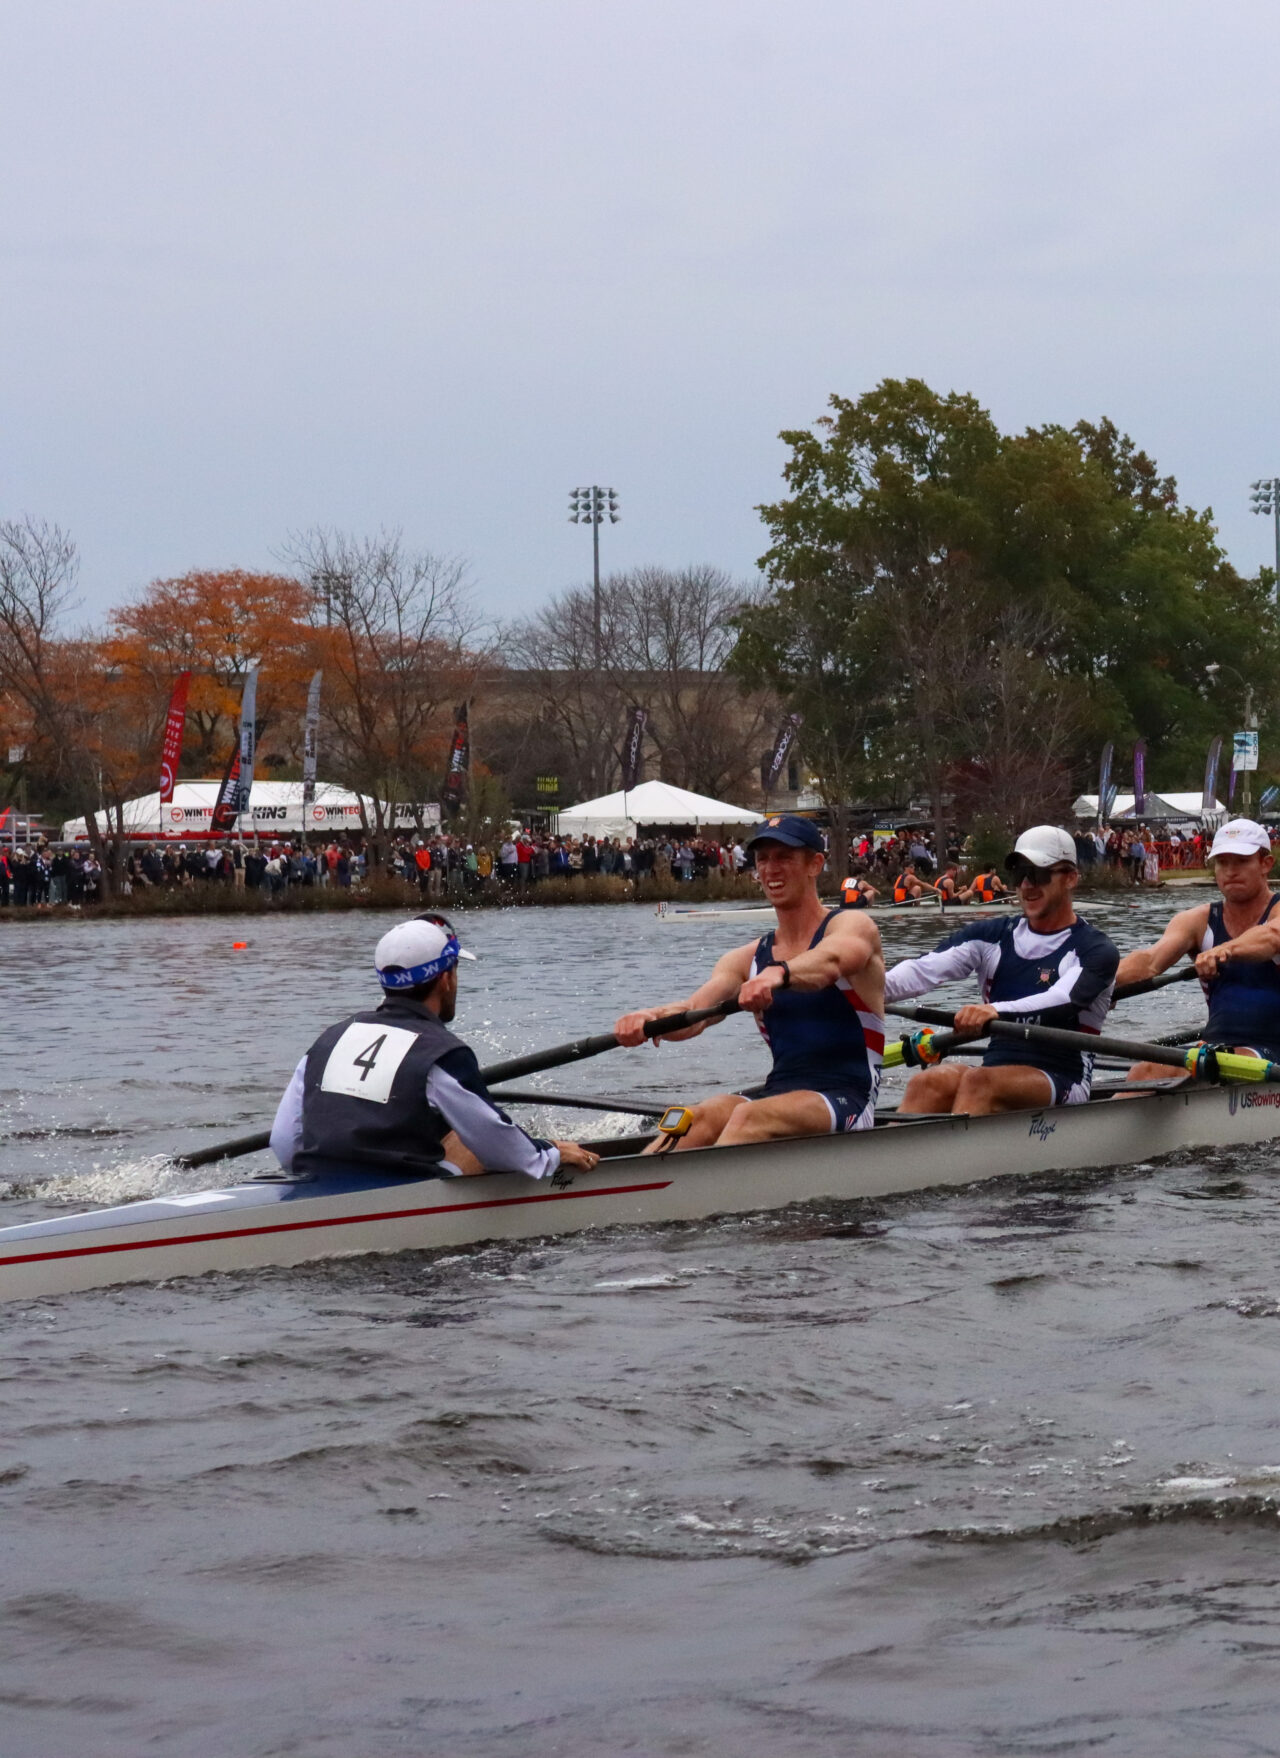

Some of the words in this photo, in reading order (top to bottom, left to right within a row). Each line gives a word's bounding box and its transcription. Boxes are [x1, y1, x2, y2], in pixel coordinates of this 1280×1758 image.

[252, 807, 287, 819] KING
[325, 806, 362, 815] WINTEC
[661, 902, 668, 913] 33
[353, 1034, 388, 1082] 4
[1240, 1089, 1280, 1109] USRowing
[1028, 1111, 1056, 1141] Filippi
